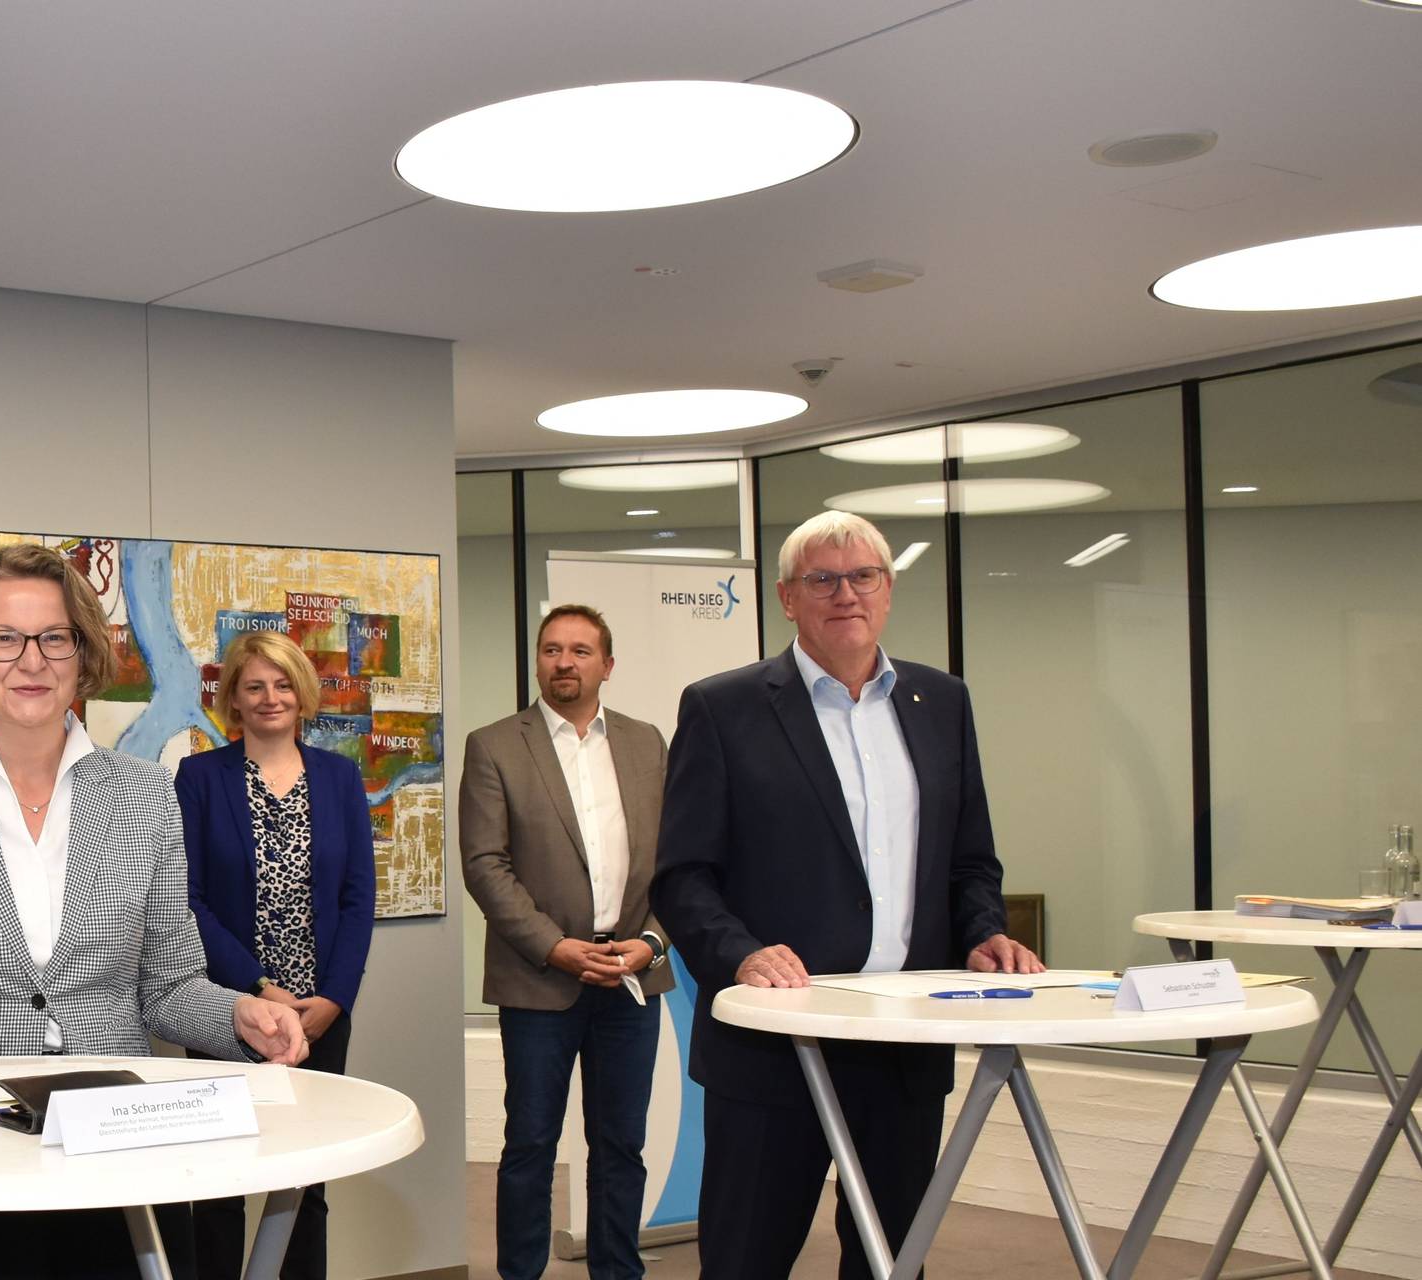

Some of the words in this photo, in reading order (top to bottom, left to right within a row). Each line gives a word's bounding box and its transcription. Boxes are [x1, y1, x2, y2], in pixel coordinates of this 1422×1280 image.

[661, 592, 696, 605] RHEIN
[698, 593, 724, 606] SIEG
[288, 607, 350, 625] SEELSCHEID
[691, 607, 721, 620] KREIS
[219, 616, 293, 634] TROISDORF
[356, 626, 388, 640] MUCH
[371, 734, 421, 750] WINDECK
[111, 1106, 129, 1116] Ina
[131, 1098, 204, 1115] Scharrenbach
